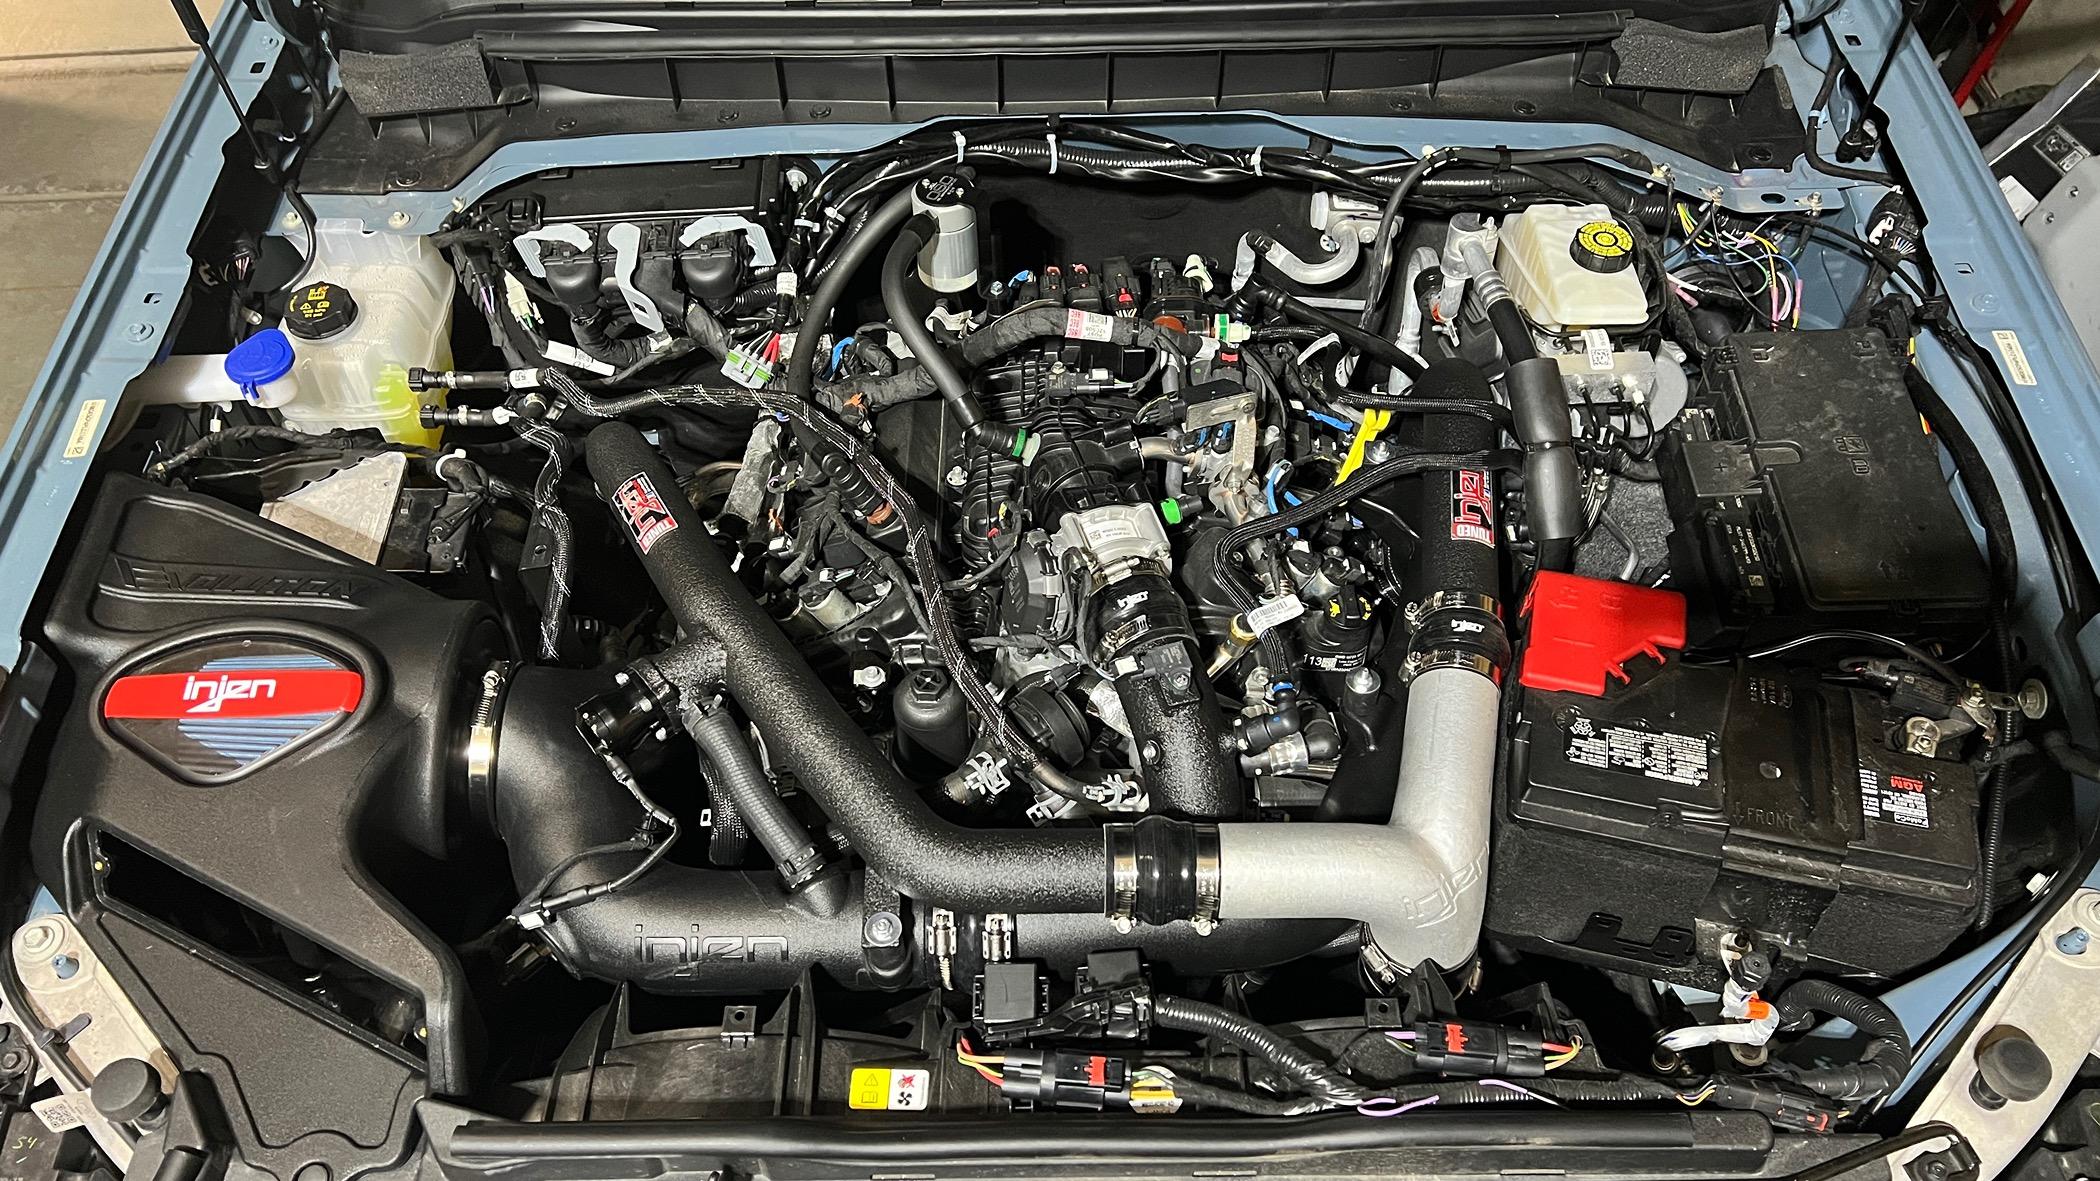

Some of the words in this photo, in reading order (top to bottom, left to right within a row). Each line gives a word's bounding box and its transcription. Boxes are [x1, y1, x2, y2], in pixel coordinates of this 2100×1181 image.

[1456, 524, 1491, 543] TUNED
[183, 675, 276, 713] injen
[1747, 807, 1795, 831] FRONT
[633, 923, 789, 980] injen
